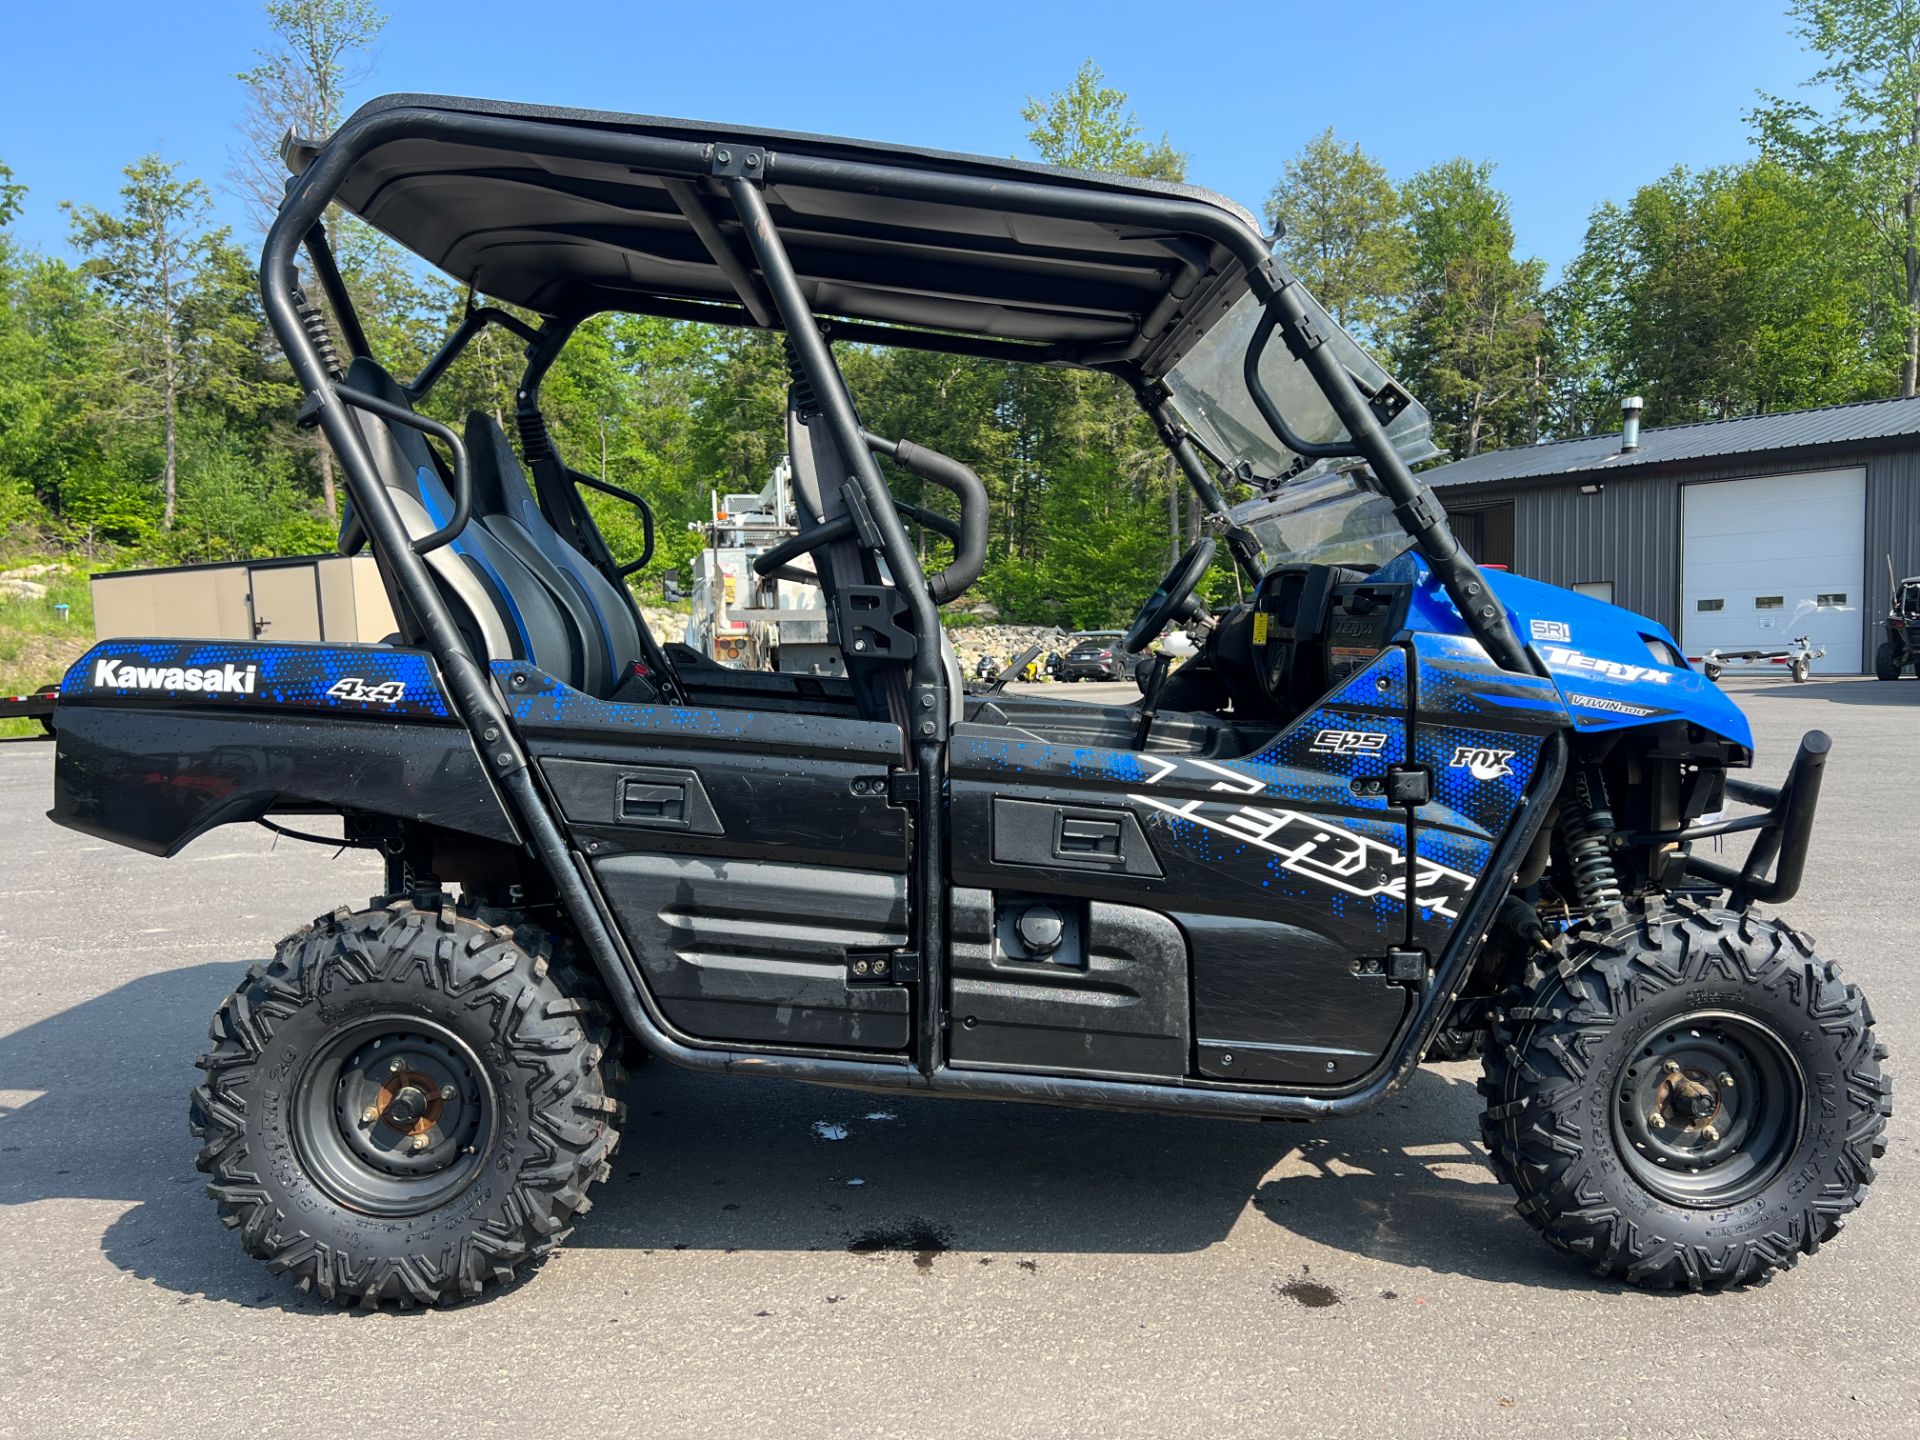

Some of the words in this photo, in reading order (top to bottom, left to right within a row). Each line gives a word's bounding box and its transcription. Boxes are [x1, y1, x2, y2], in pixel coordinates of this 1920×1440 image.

[1532, 621, 1569, 637] SR1
[95, 659, 256, 694] Kawasaki
[327, 678, 406, 703] 4x4
[1314, 730, 1387, 751] EPS
[1449, 747, 1516, 770] FOX
